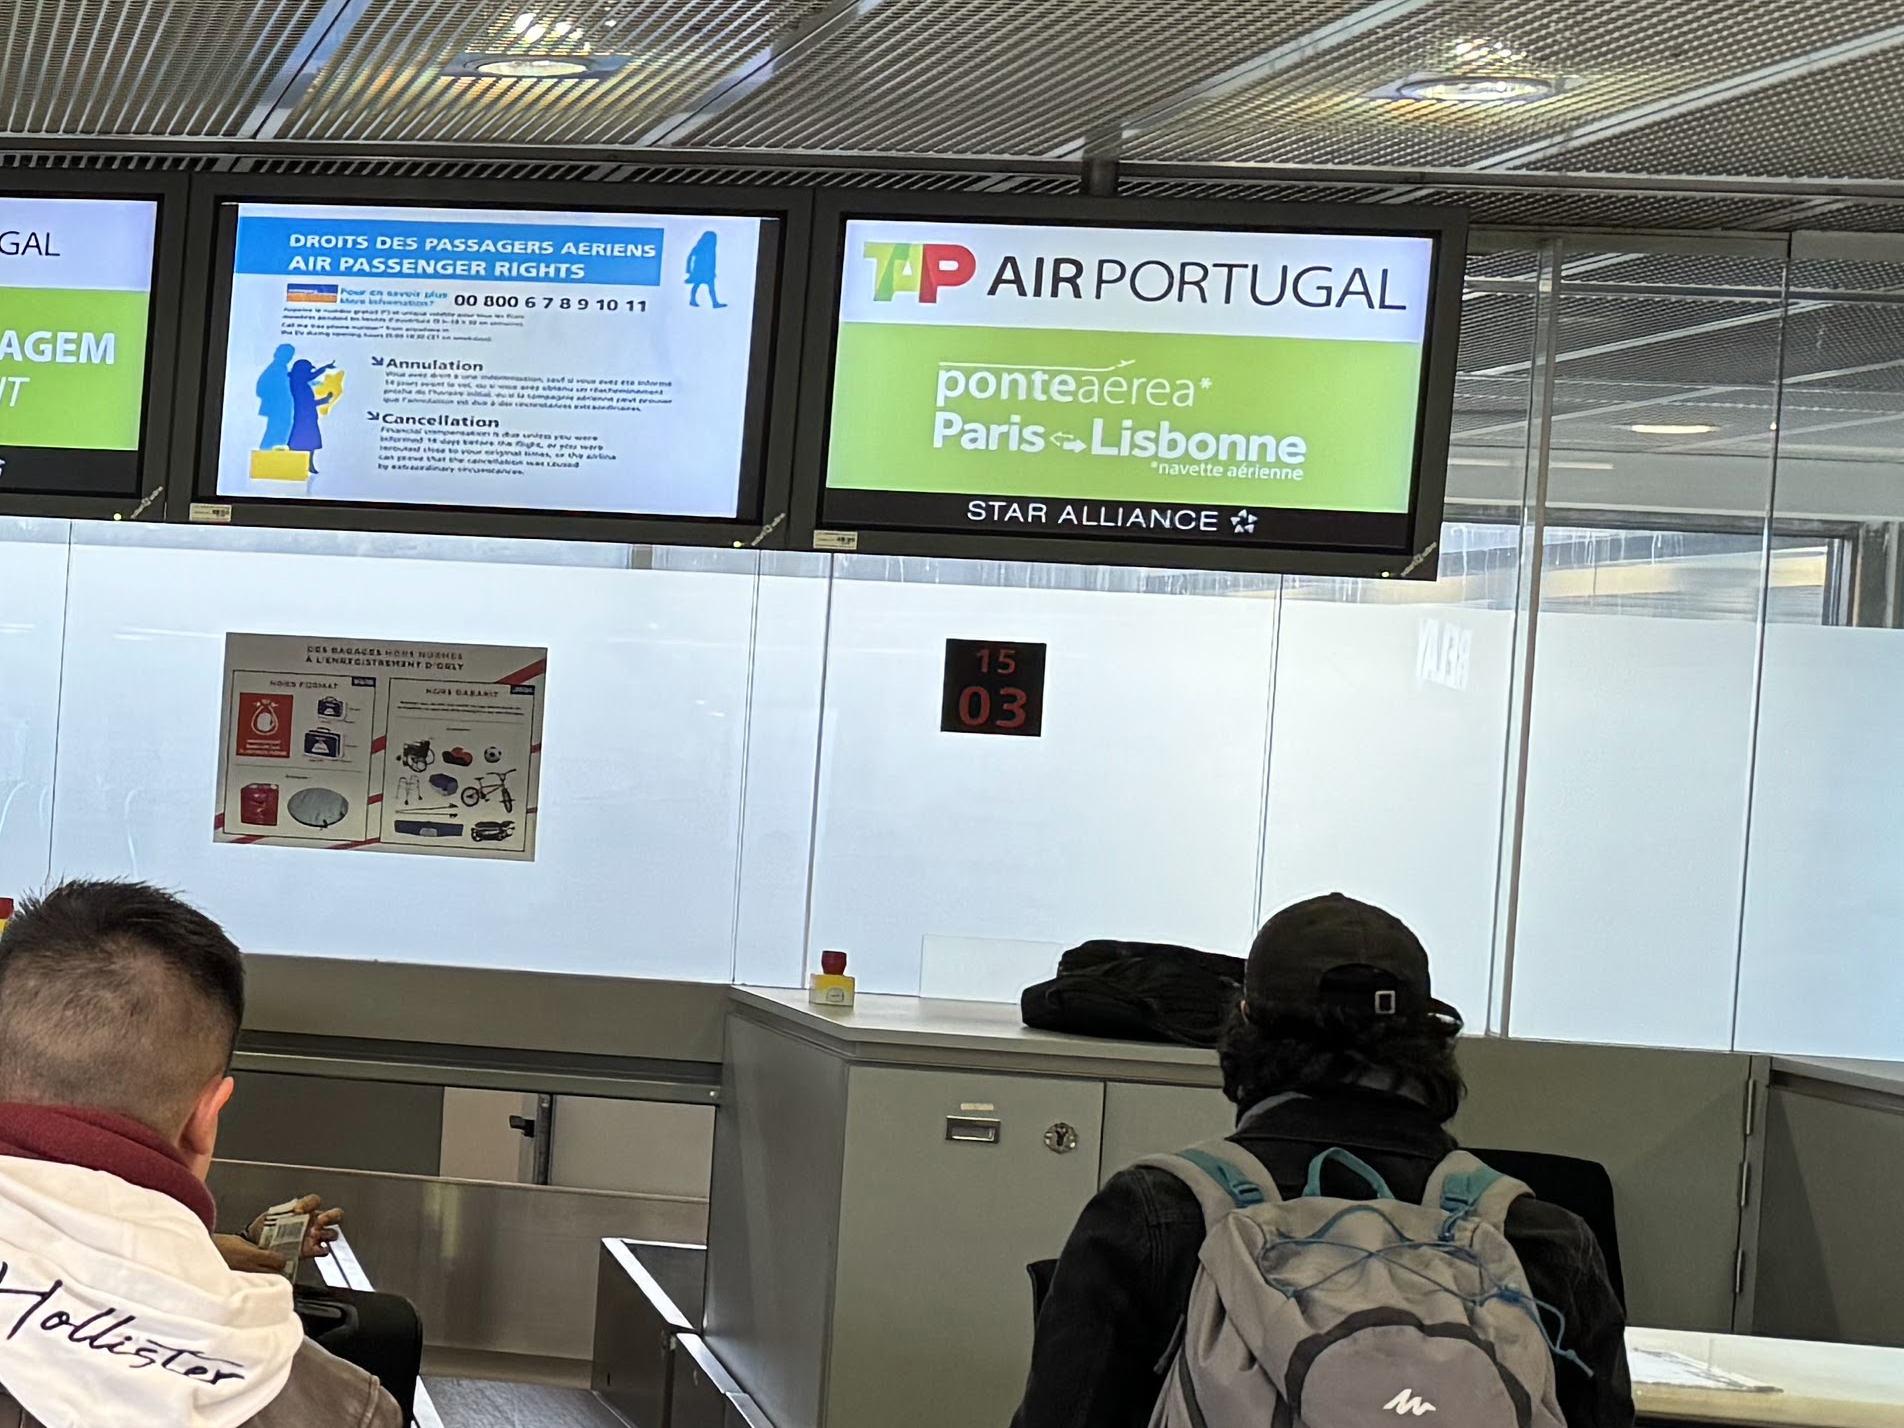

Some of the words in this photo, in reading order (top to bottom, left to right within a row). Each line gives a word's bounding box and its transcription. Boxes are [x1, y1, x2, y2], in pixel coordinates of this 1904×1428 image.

[290, 234, 368, 249] DROITS
[376, 237, 418, 251] DES
[425, 239, 553, 255] PASSAGERS
[561, 242, 656, 257] AERIENS
[289, 257, 332, 272] AIR
[340, 258, 486, 276] PASSENGER
[495, 262, 585, 279] RIGHTS
[863, 242, 976, 303] TAP
[454, 294, 477, 307] 00
[484, 296, 518, 308] 800
[525, 296, 536, 308] 6
[543, 297, 553, 309] 7
[560, 298, 571, 310] 8
[578, 298, 589, 310] 9
[596, 299, 618, 312] 10
[627, 300, 646, 312] 11
[387, 358, 484, 372] Annulation
[382, 413, 500, 428] Cancellation
[933, 411, 1046, 453] Paris
[1092, 418, 1306, 464] Lisbonne
[1227, 464, 1304, 481] aérienne
[968, 501, 1047, 523] STAR
[1058, 504, 1218, 531] ALLIANCE
[976, 649, 1016, 674] 15
[959, 685, 1027, 729] 03
